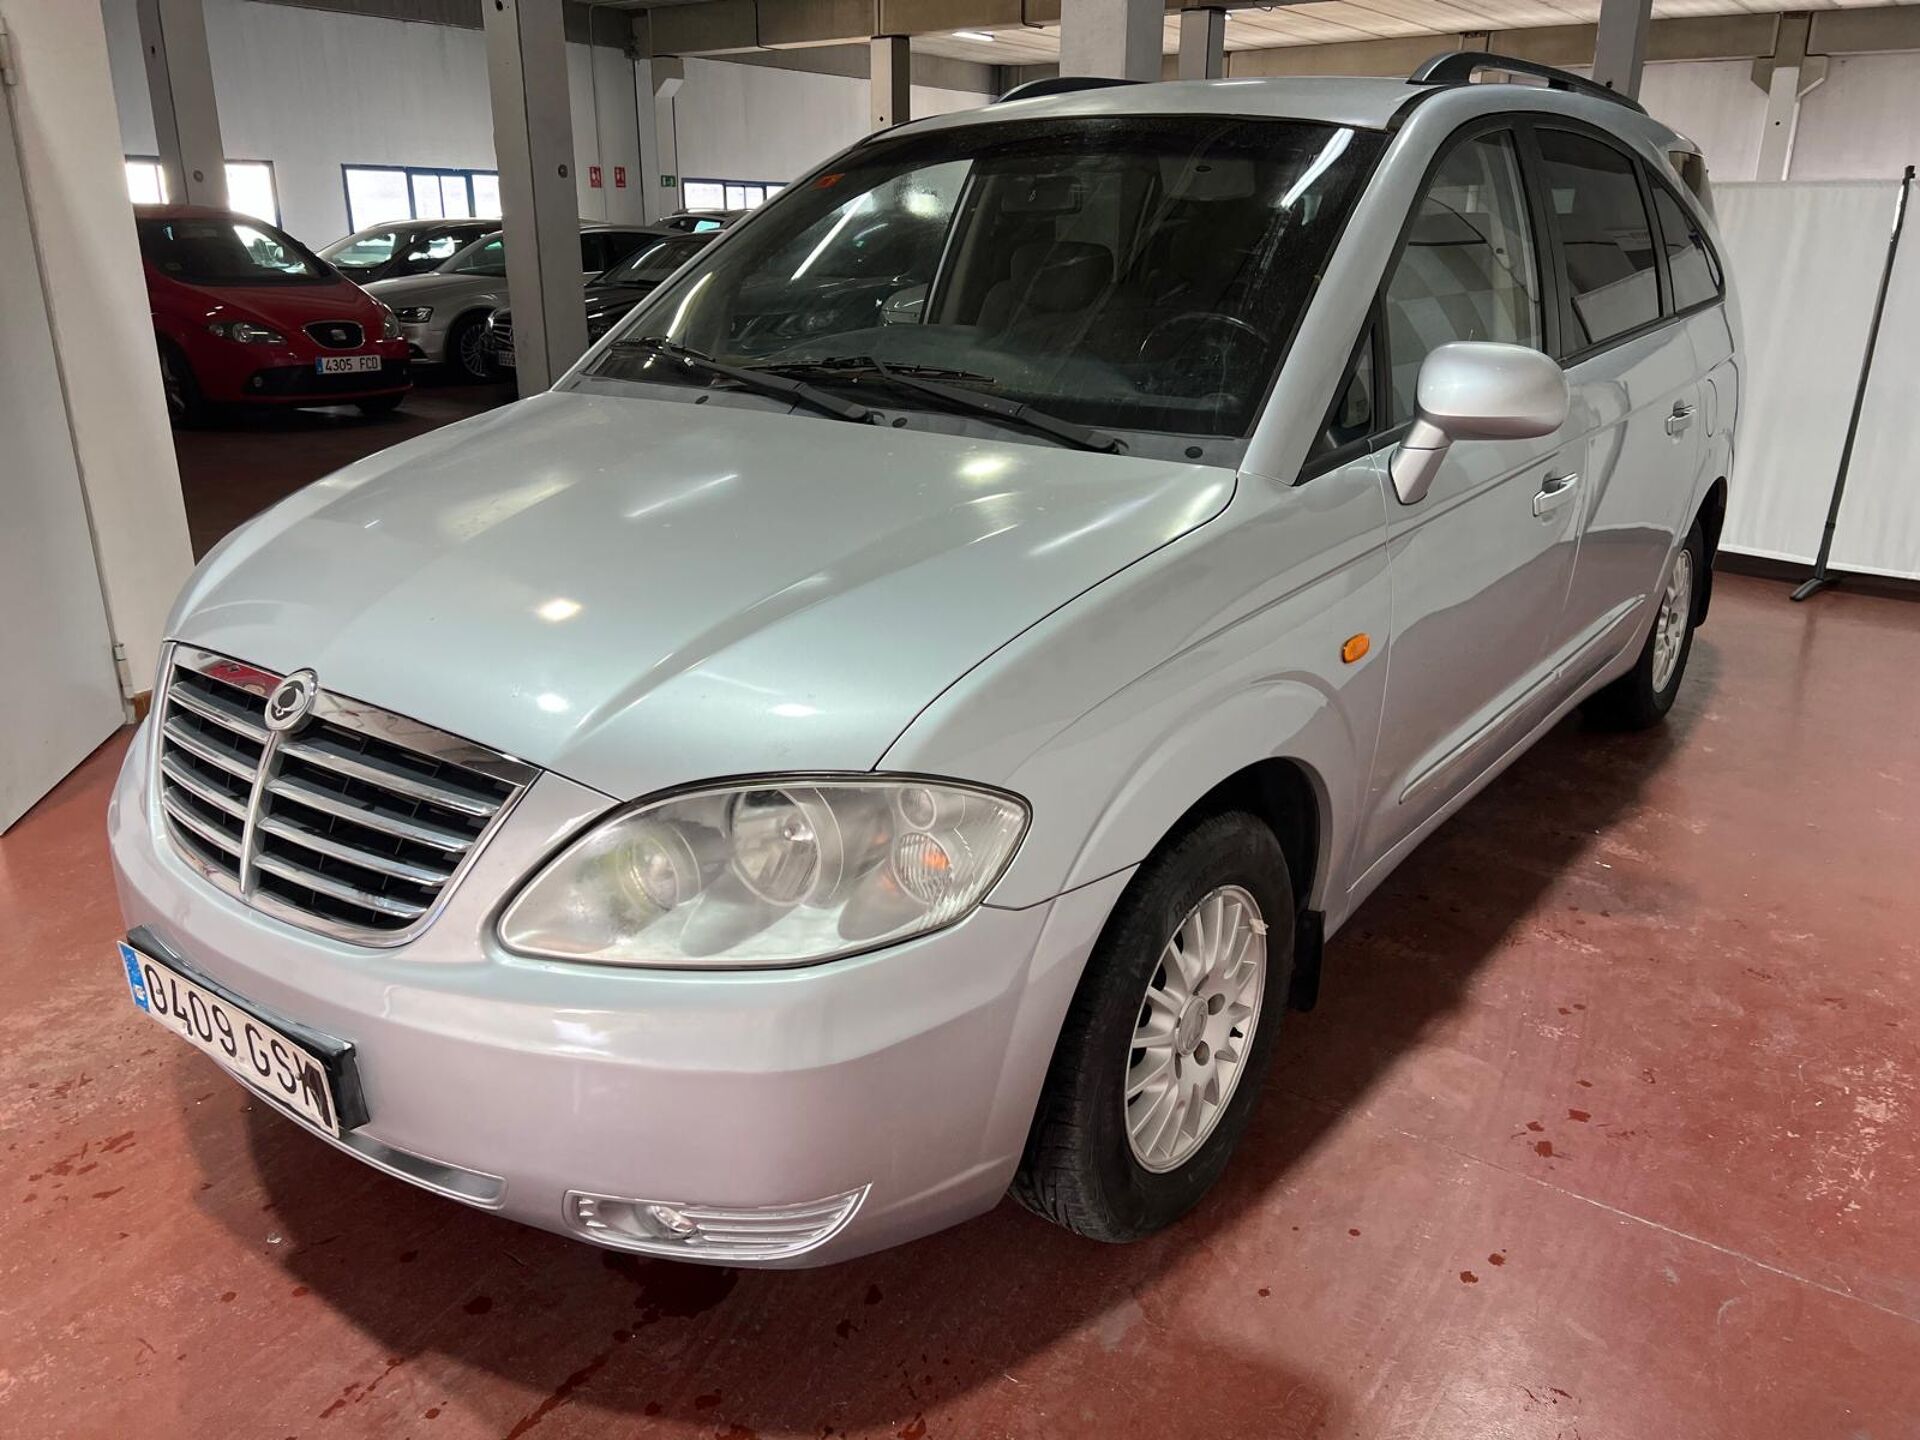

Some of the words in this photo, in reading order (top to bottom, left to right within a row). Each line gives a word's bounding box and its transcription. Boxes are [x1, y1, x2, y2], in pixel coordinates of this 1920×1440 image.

[325, 358, 353, 371] 4305
[360, 356, 378, 369] FCD
[144, 963, 237, 1058] 0409
